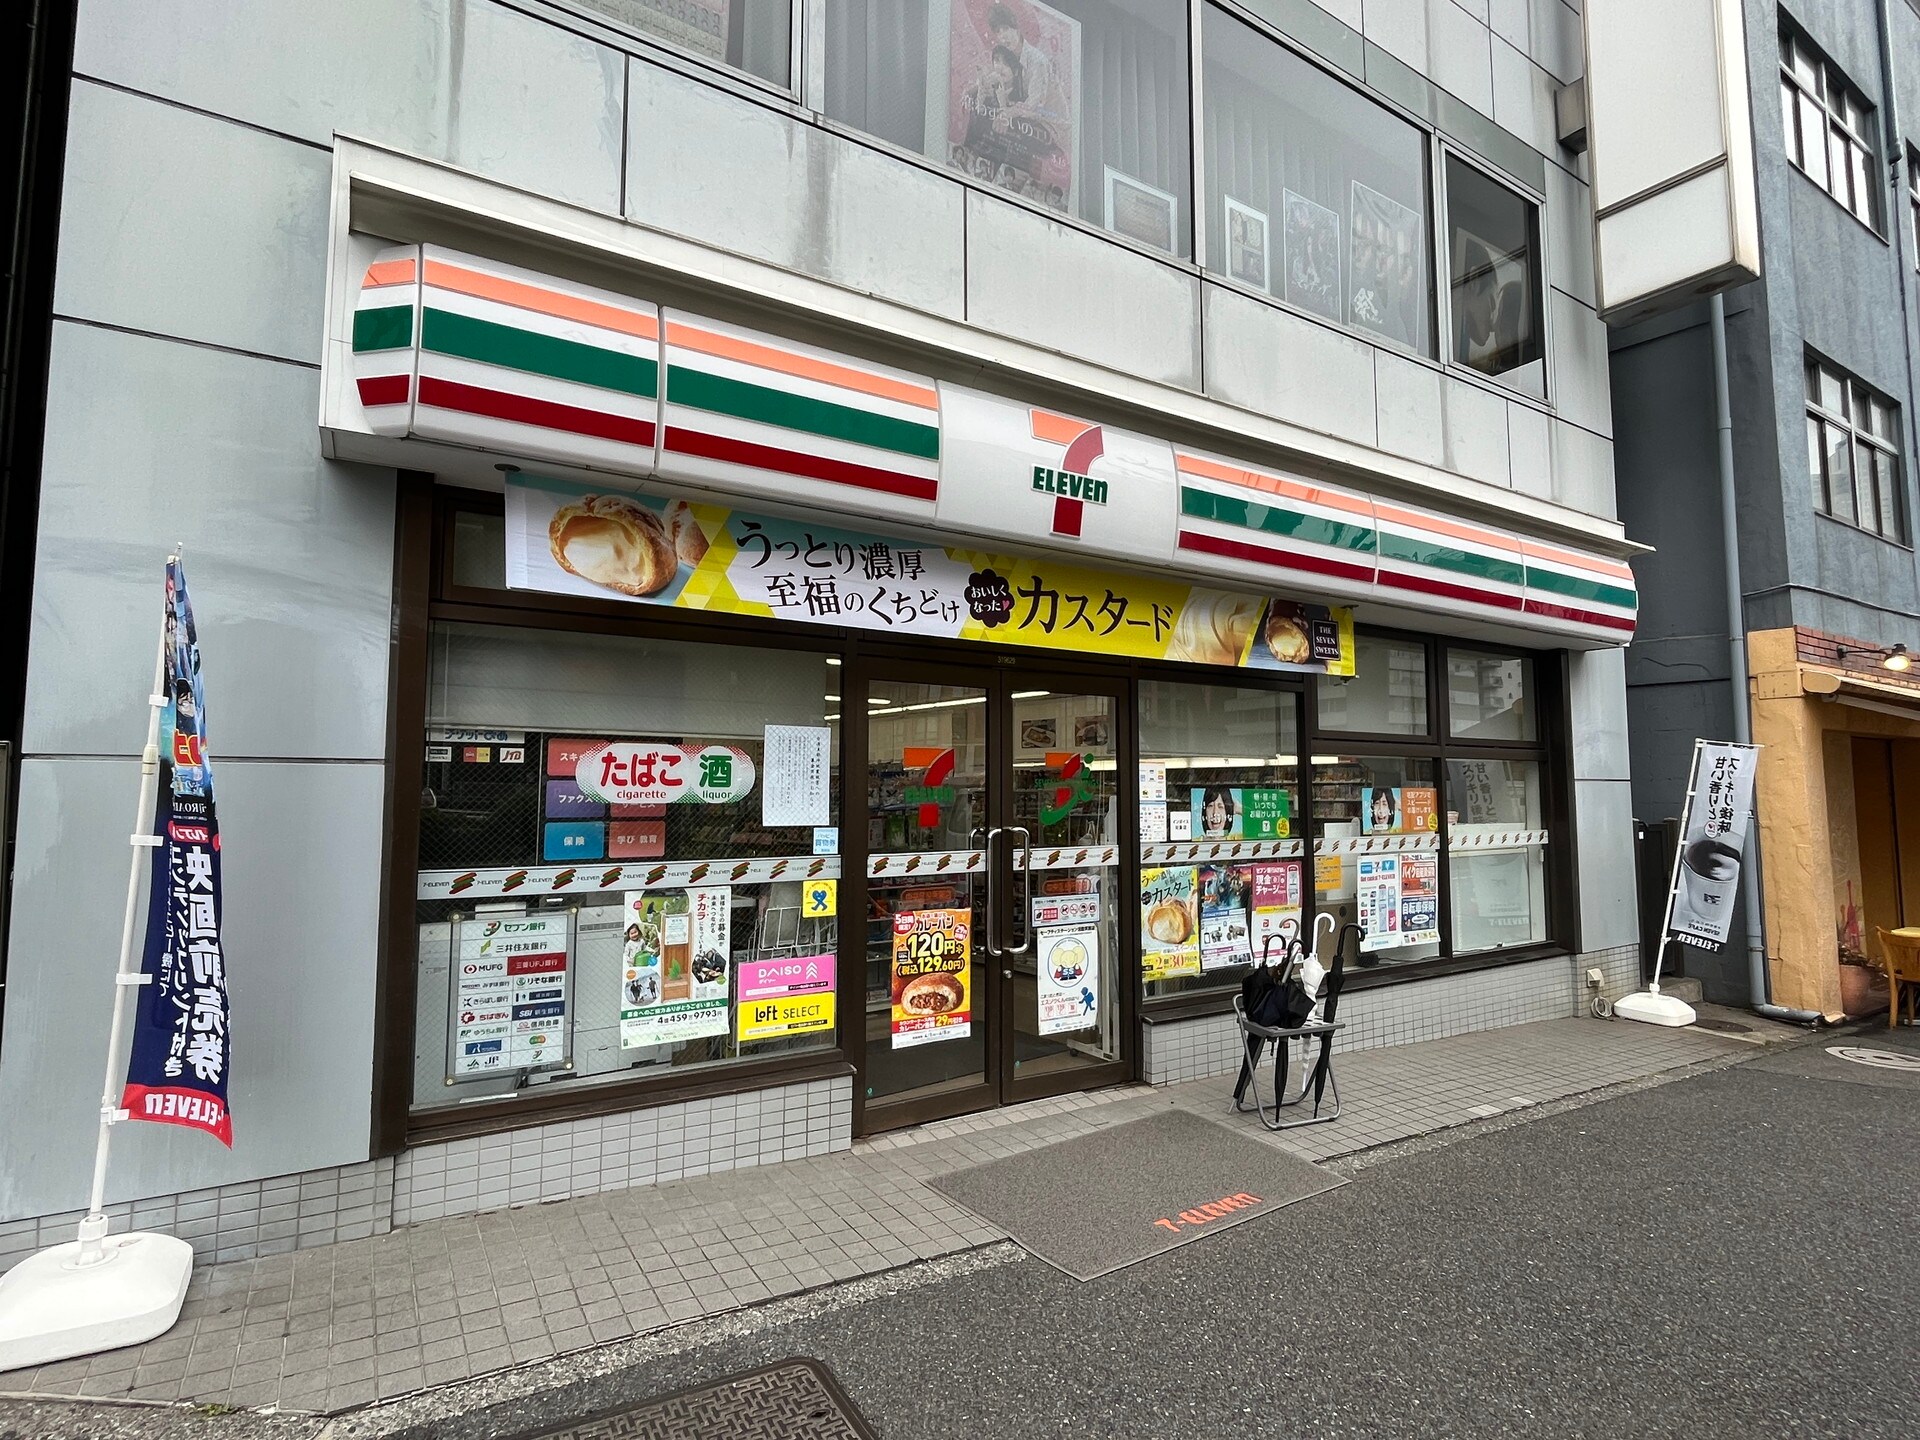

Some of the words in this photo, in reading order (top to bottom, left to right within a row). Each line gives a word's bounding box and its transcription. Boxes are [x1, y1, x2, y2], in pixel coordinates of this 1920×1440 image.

[736, 519, 926, 581] うっとり濃厚
[970, 584, 1007, 599] おいしく
[763, 571, 960, 625] 至福のくちどけ
[1017, 575, 1174, 642] カスタード
[1319, 626, 1331, 634] THE
[1316, 636, 1336, 645] SEVEN
[1315, 647, 1339, 656] SWEETS
[502, 750, 522, 761] JTB
[600, 751, 684, 787] たばこ
[698, 754, 733, 788] 酒
[616, 790, 667, 801] cigarette
[702, 789, 733, 801] liquor
[1254, 802, 1277, 810] いつでも
[563, 836, 585, 846] 保険
[617, 836, 635, 845] 学び
[1256, 875, 1271, 885] 現金
[1152, 878, 1195, 906] カスタード
[1256, 884, 1279, 896] チャージ
[1402, 899, 1435, 916] 自転車保険
[504, 921, 546, 933] セブン銀行
[916, 915, 954, 932] カレーパン
[496, 941, 547, 953] 三井住友銀行
[479, 963, 503, 972] MUFG
[515, 959, 558, 969] 三菱UFJ銀行
[758, 964, 802, 978] DAISO
[1062, 967, 1075, 976] SS
[482, 981, 510, 989] みずほ銀行
[527, 975, 563, 985] りそな銀行
[473, 995, 509, 1005] きらぼし銀行
[479, 1012, 509, 1021] ちばぎん
[519, 1009, 532, 1018] SBI
[535, 1008, 560, 1016] 新生銀行
[782, 1005, 821, 1019] SELECT
[531, 1019, 559, 1028] 信用金庫
[474, 1027, 509, 1036] ゆうちょ銀行
